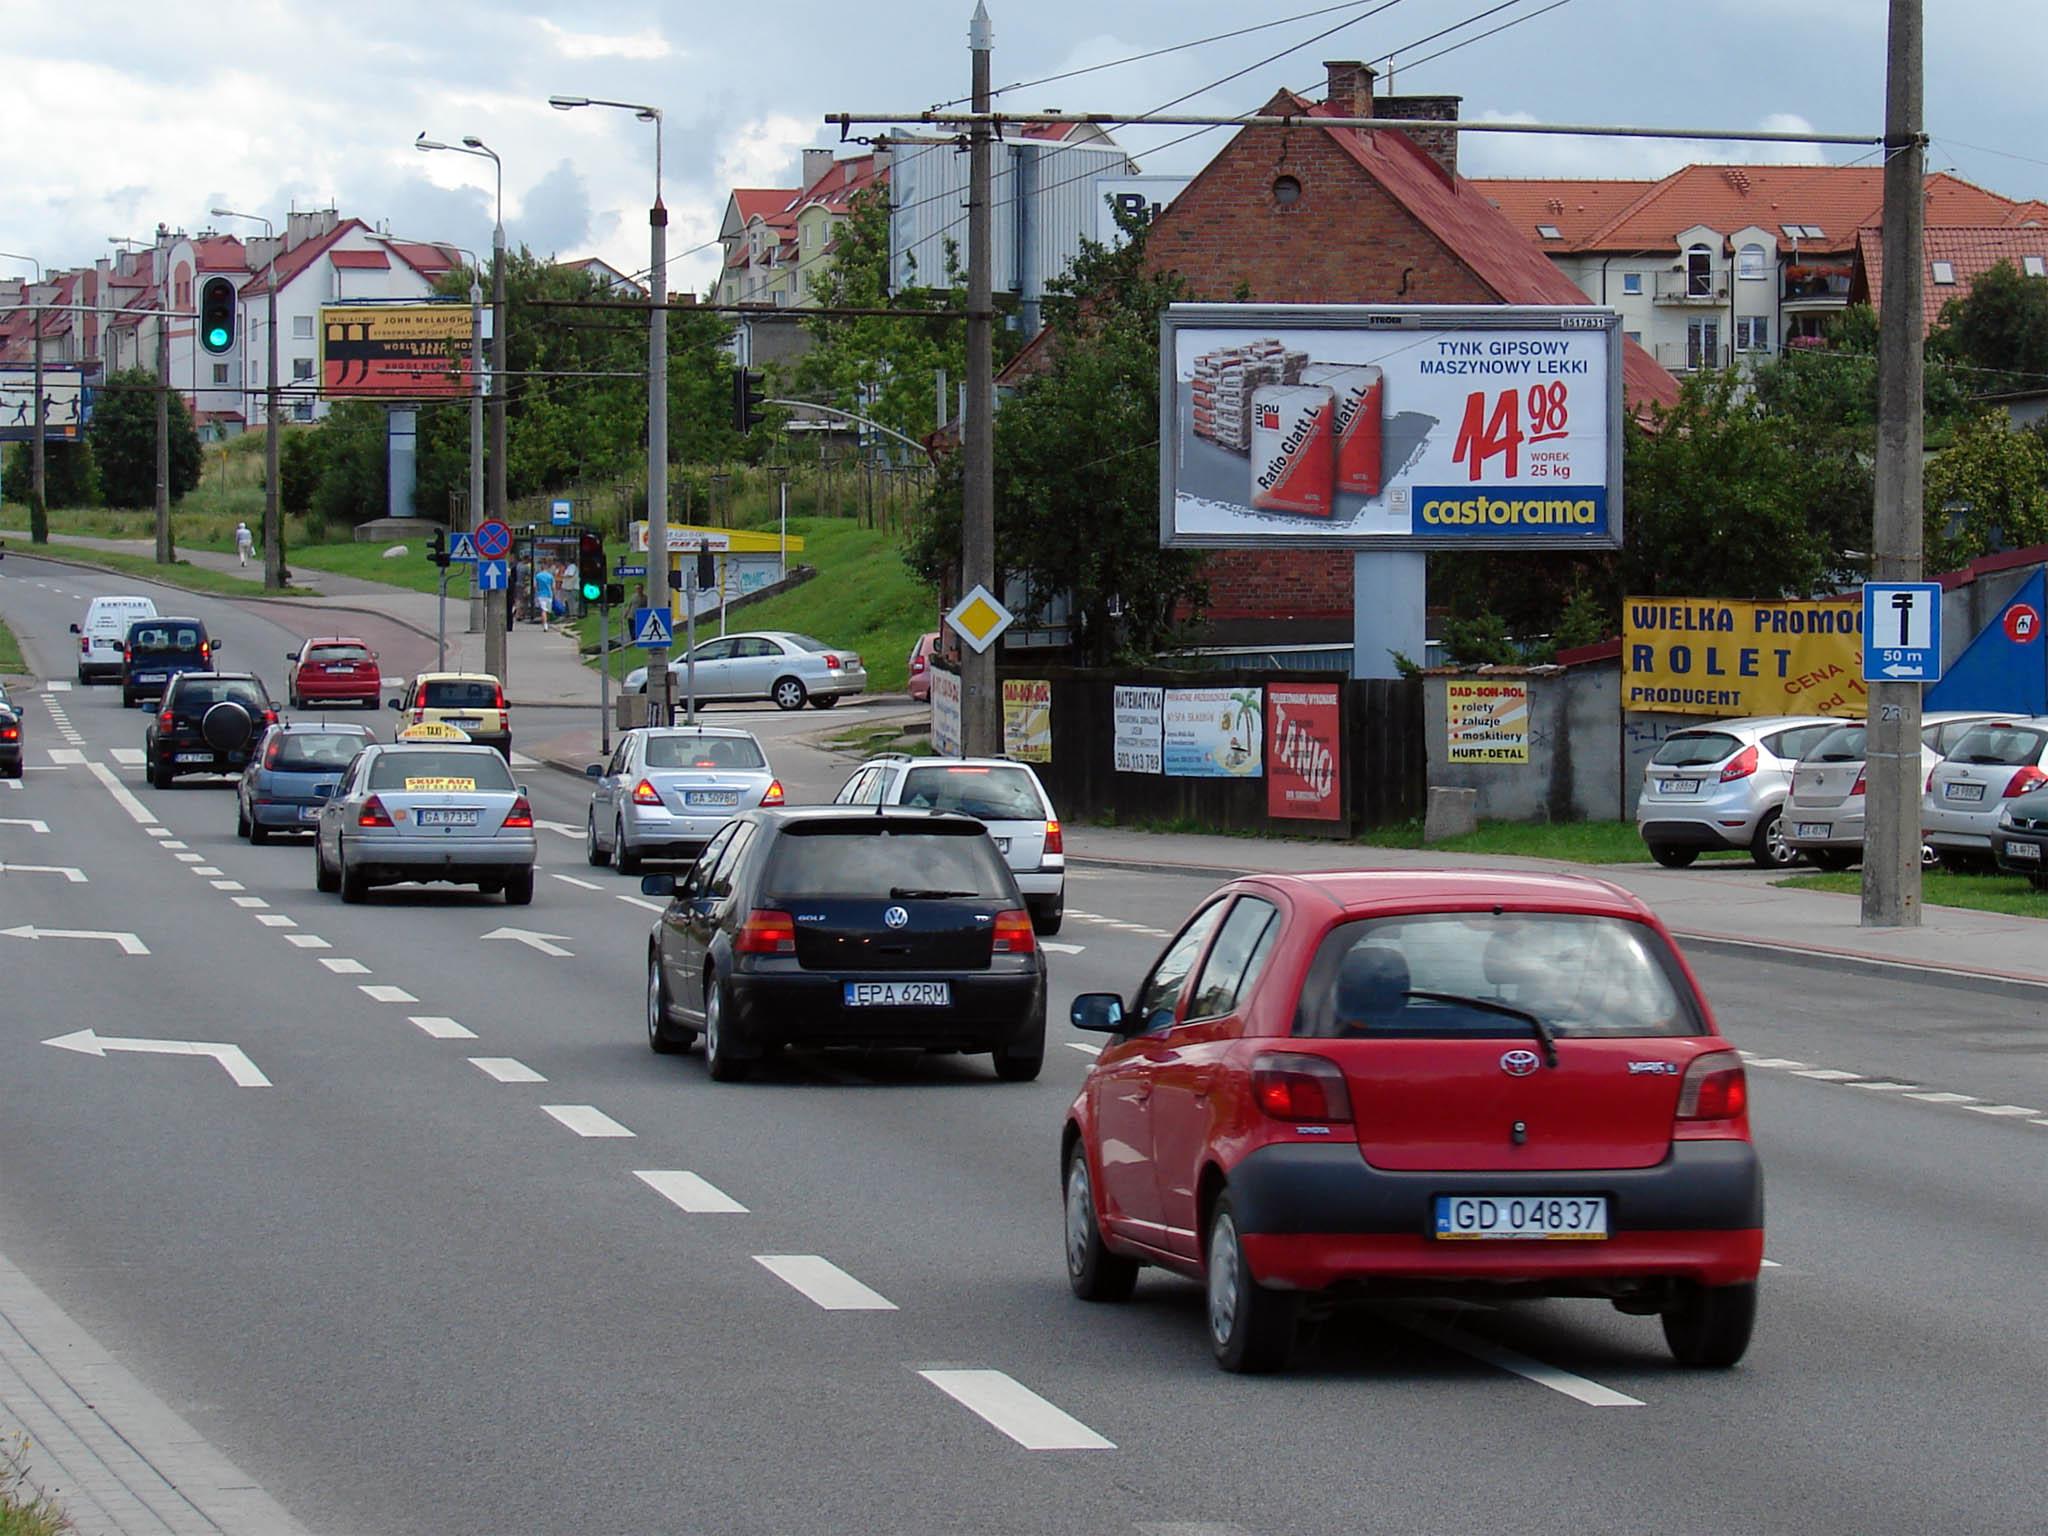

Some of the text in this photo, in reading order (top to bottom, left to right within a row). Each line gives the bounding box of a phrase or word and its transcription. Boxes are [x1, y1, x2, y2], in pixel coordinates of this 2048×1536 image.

[384, 316, 472, 325] JOHN McLAUGHLI
[1438, 341, 1570, 355] TYNK GIPSOWY
[1420, 360, 1588, 374] MASZYNOWY LEKKI
[1350, 387, 1367, 399] L
[1452, 380, 1568, 482] 14 98
[1257, 407, 1320, 491] Ratio Glatt L
[1531, 452, 1569, 462] WOREK
[1531, 464, 1570, 479] 25 kg
[1423, 496, 1595, 524] castorama
[1632, 606, 1734, 632] WIELKA
[1631, 644, 1792, 678] ROLET
[1883, 650, 1922, 662] 50 m
[1784, 663, 1845, 695] CENA
[1115, 690, 1161, 709] MATEMATYKA
[1450, 687, 1525, 698] DAD-SON-ROL
[1630, 687, 1741, 706] PRODUCENT
[1461, 703, 1494, 714] rolety
[1818, 693, 1846, 711] od
[427, 726, 442, 736] TAXI
[1462, 730, 1522, 742] moskitiery
[425, 811, 440, 822] GA
[857, 984, 945, 1002] EPA 62RM
[1456, 1200, 1600, 1230] GD 04837
